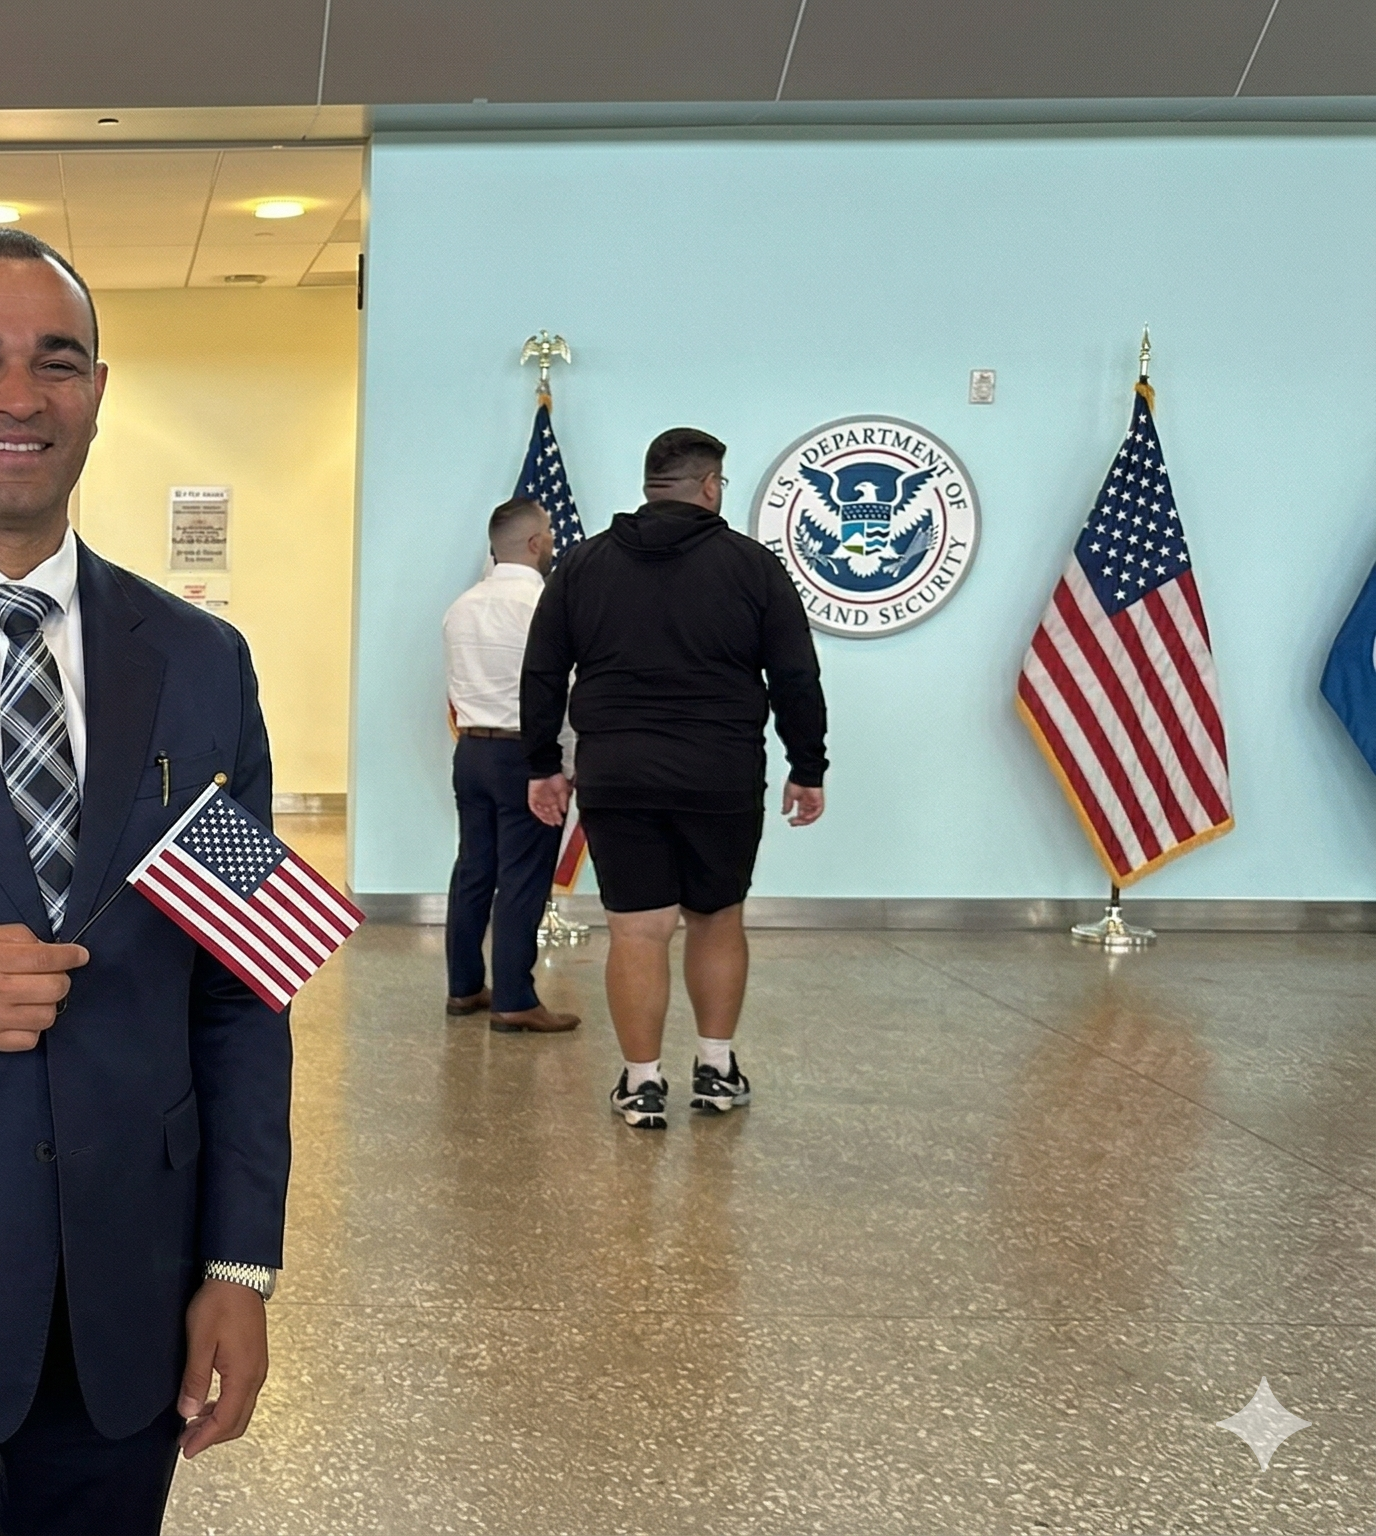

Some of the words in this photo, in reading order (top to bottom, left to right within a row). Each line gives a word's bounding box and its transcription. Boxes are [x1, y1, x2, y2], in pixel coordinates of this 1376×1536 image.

[767, 475, 799, 509] U.S.
[802, 428, 953, 478] DEPARTMENT
[945, 481, 968, 511] OF
[879, 535, 967, 625] SECURITY
